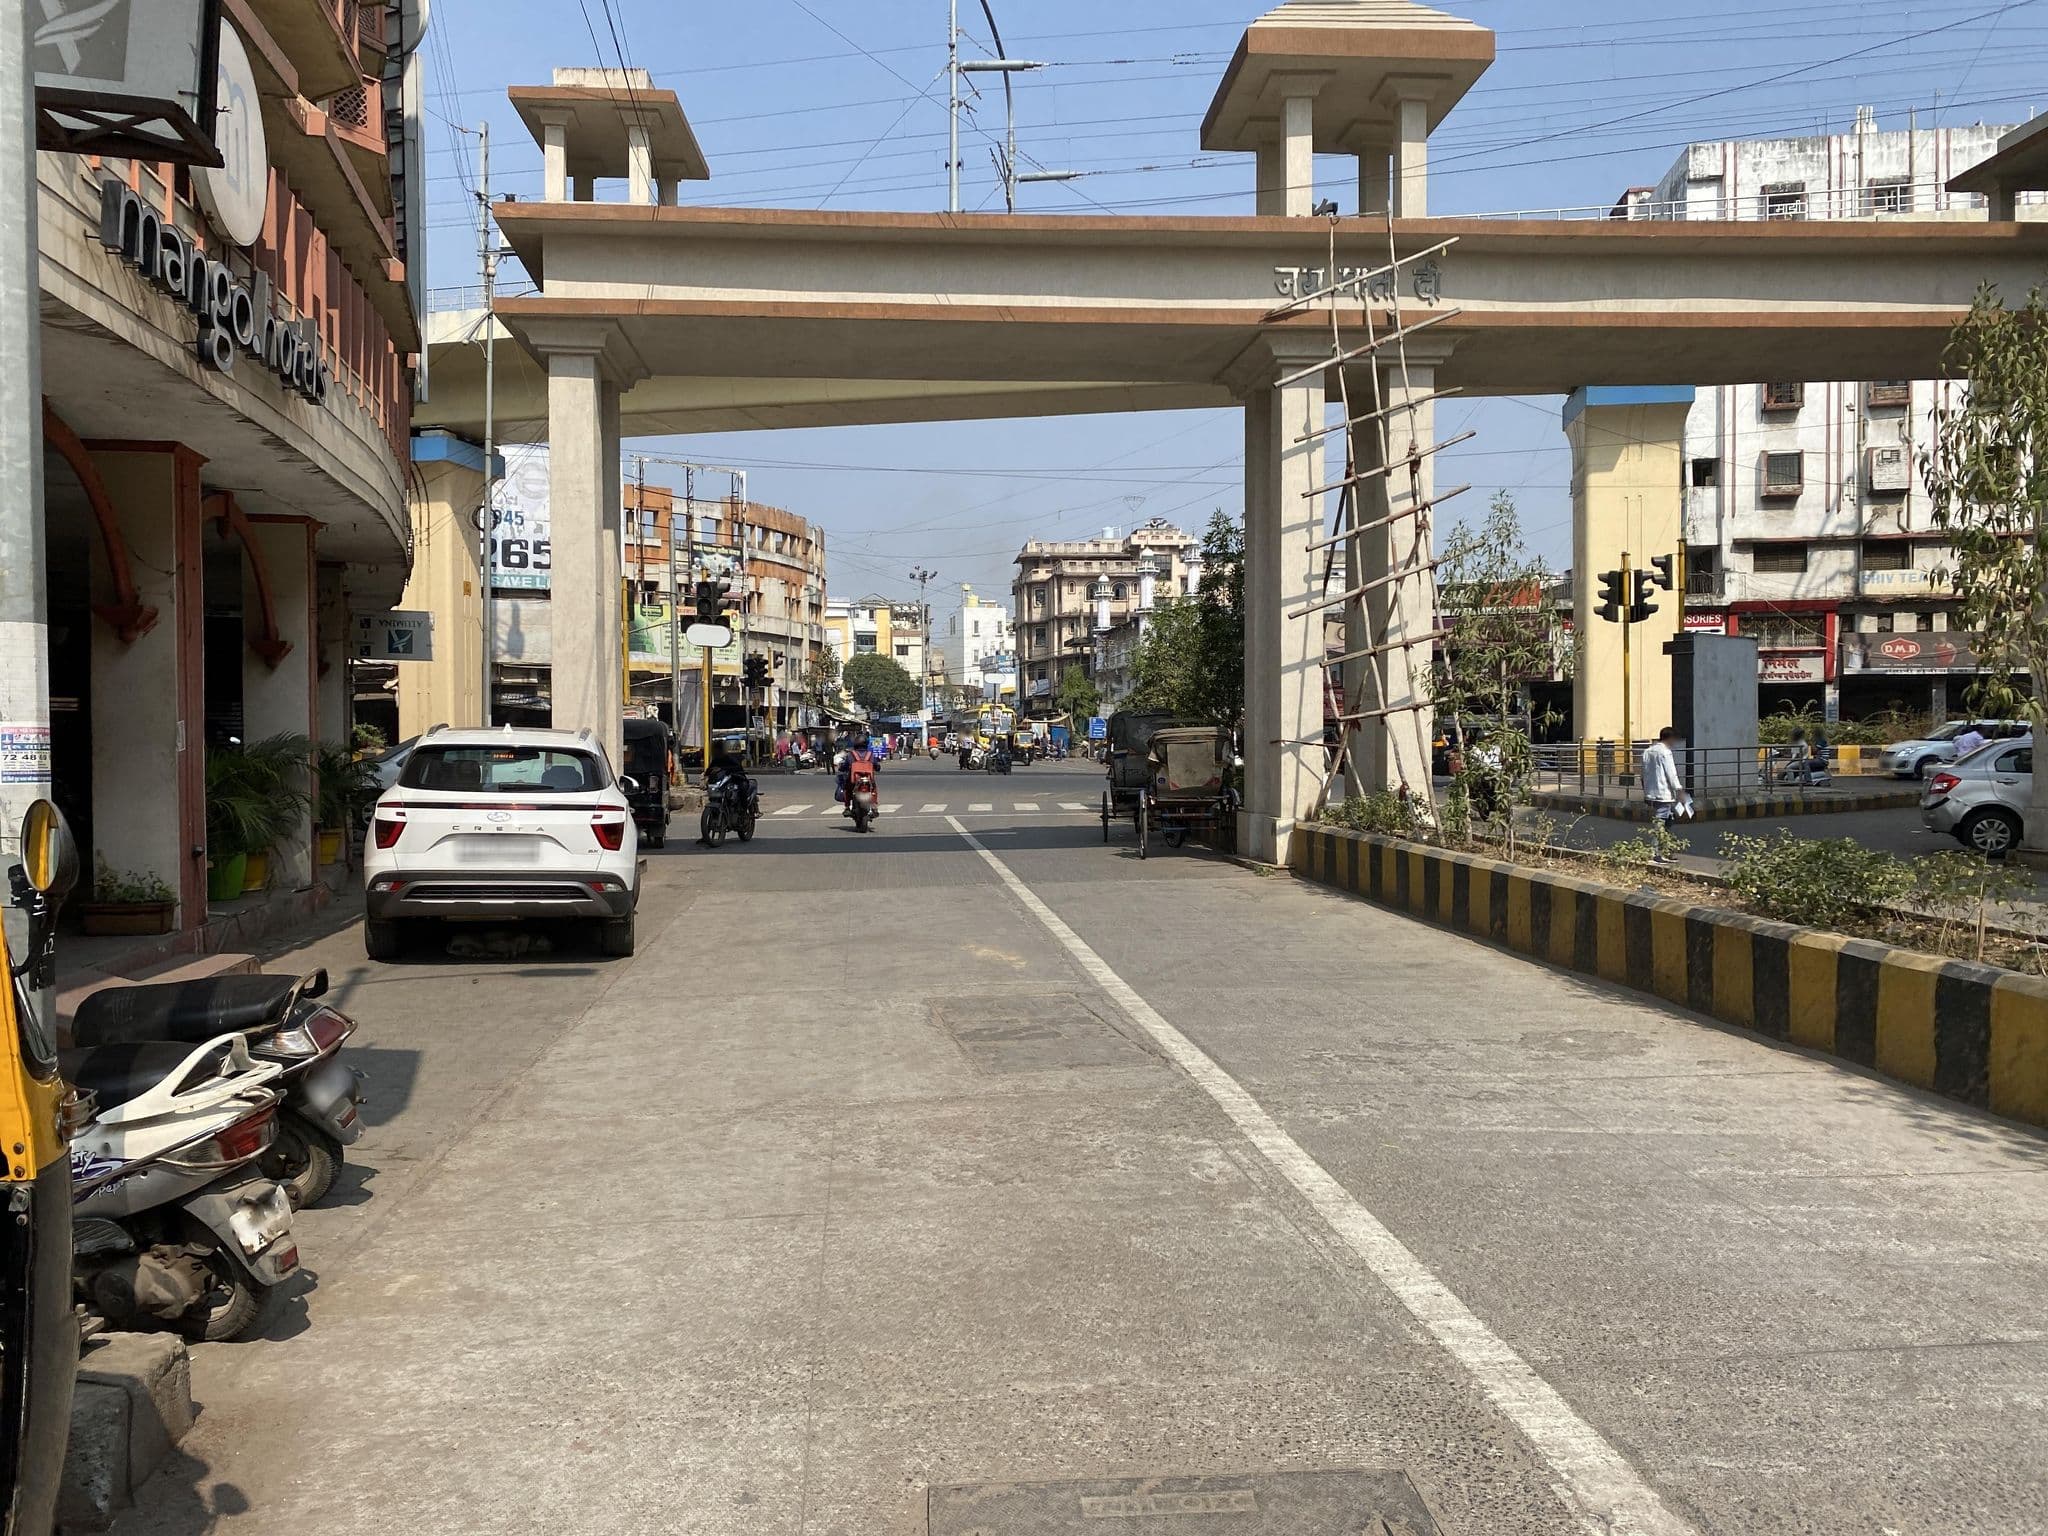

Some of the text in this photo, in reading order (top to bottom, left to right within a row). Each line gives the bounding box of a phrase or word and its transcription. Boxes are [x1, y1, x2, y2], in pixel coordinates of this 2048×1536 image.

[100, 178, 254, 372] mango
[1274, 266, 1325, 302] जय
[491, 576, 532, 587] SAVE
[1861, 573, 1894, 584] SHIV
